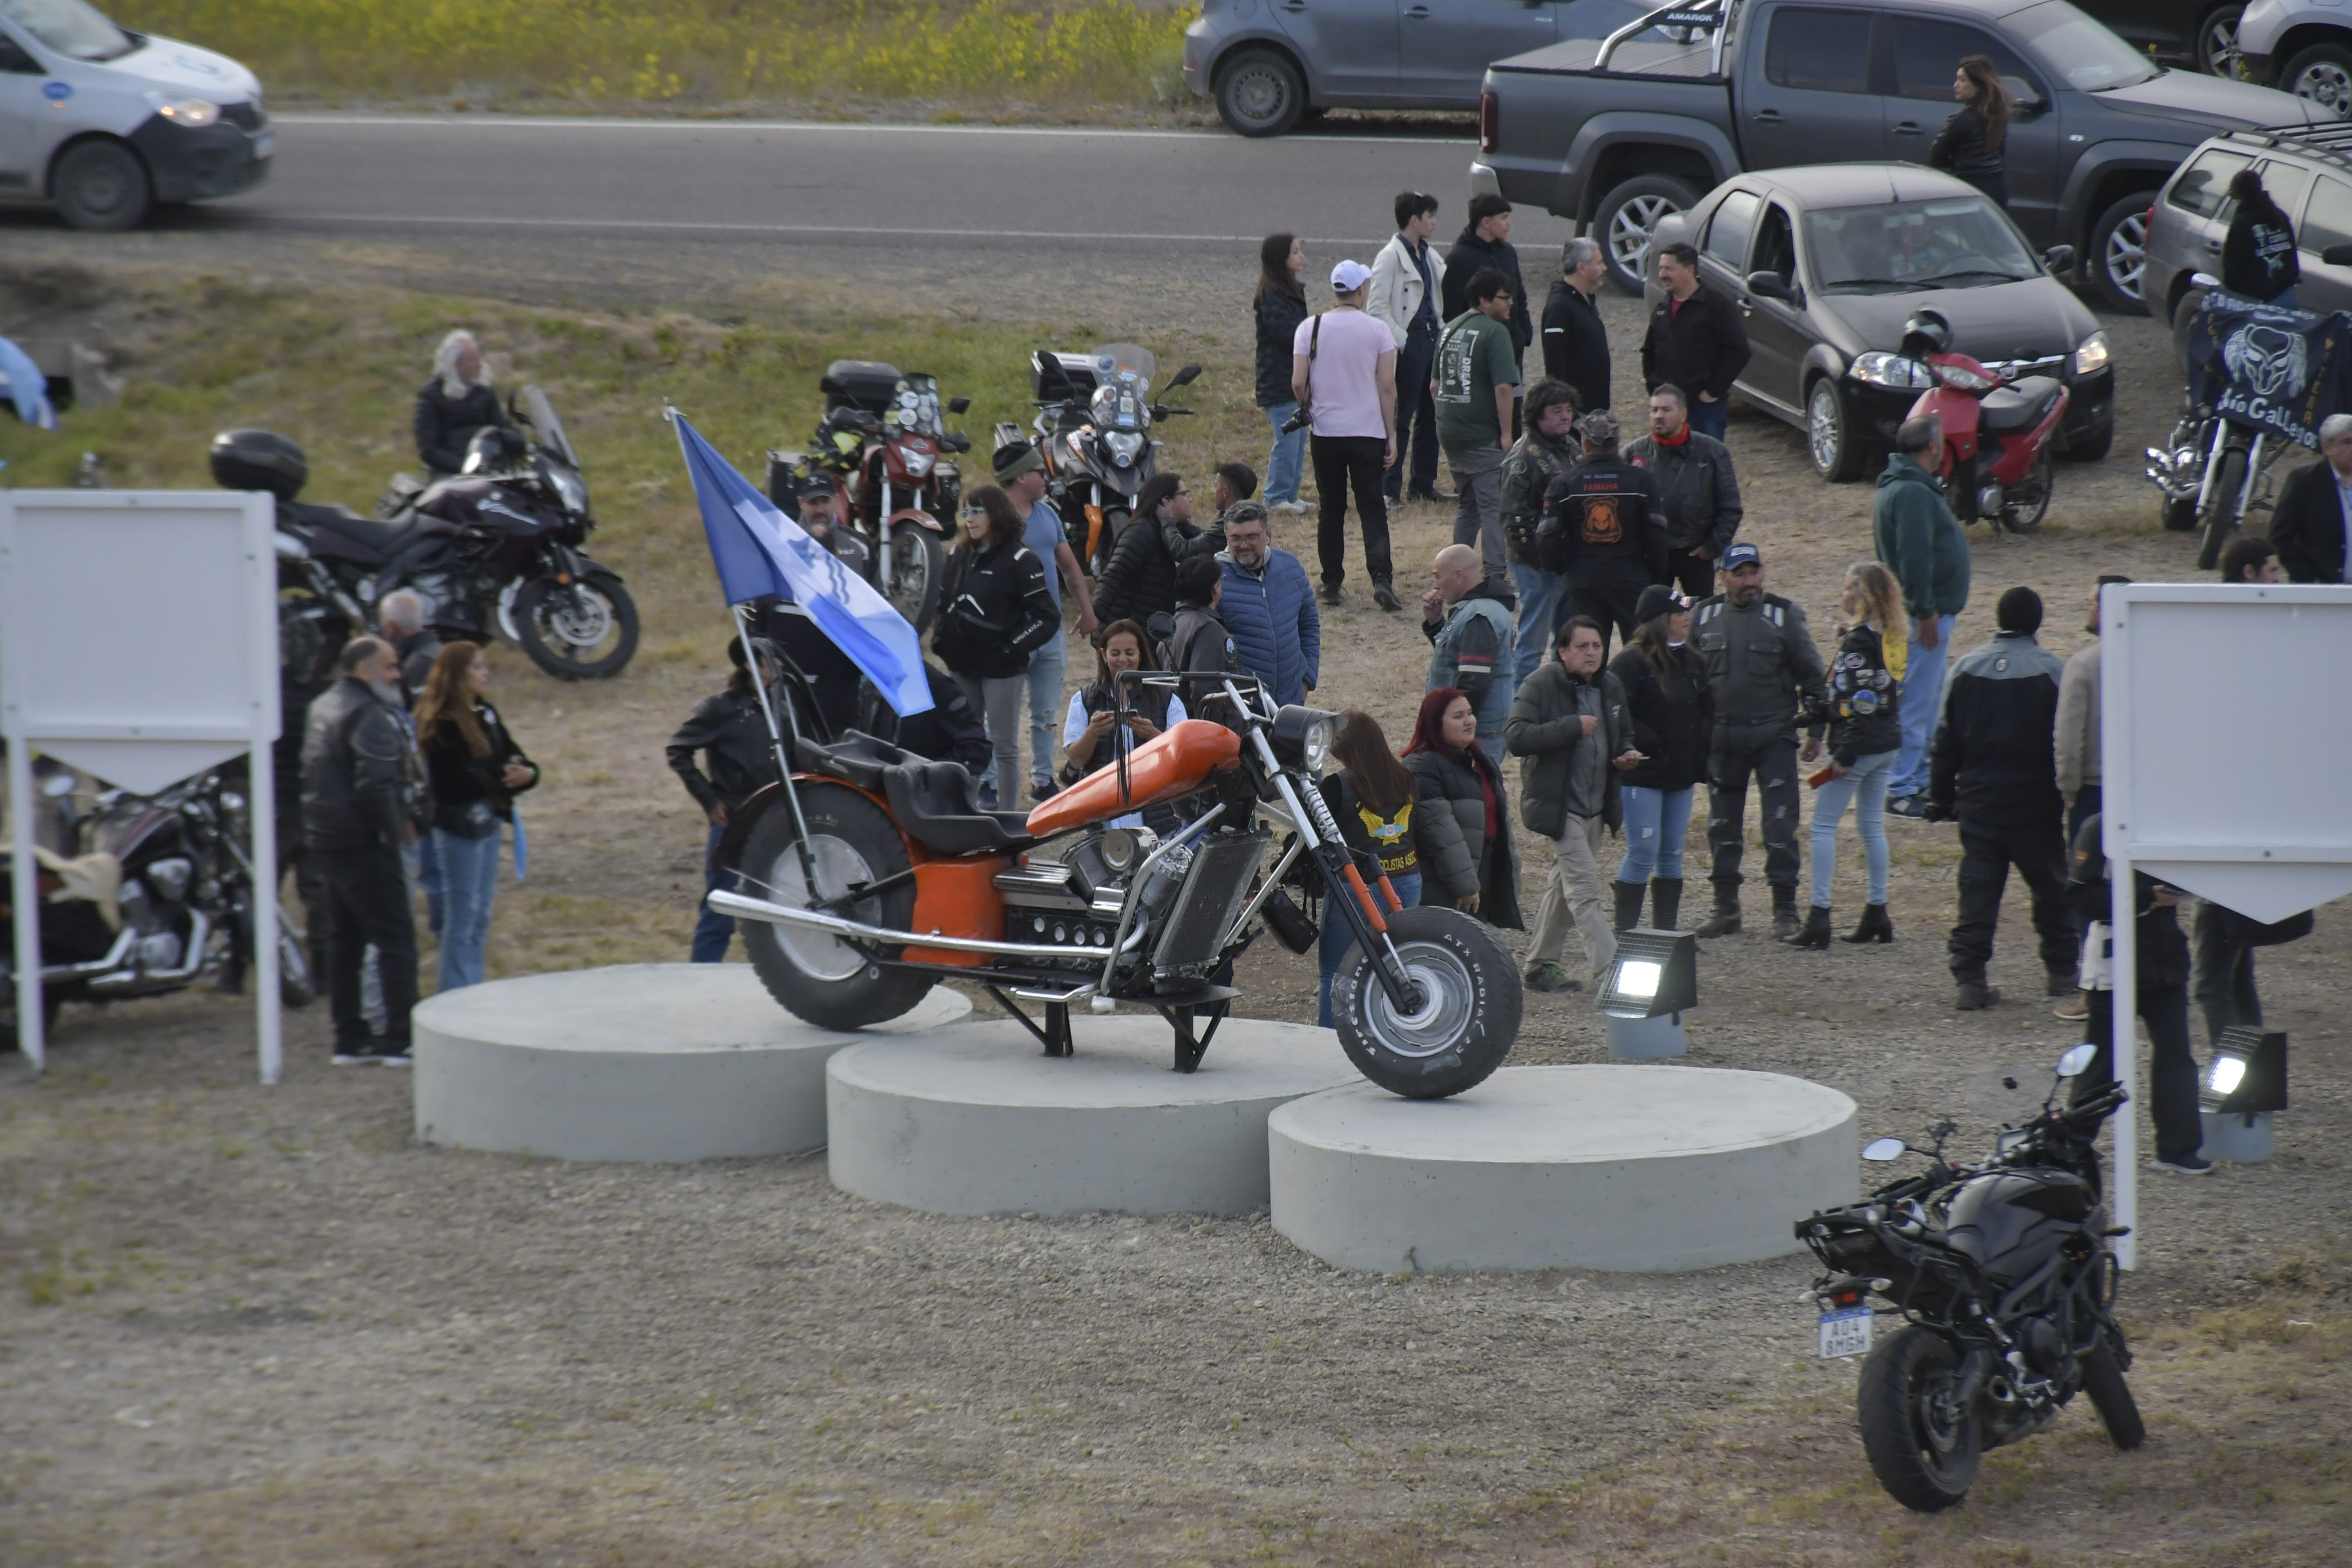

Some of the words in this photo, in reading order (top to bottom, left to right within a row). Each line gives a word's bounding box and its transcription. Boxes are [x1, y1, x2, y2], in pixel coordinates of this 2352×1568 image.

[1667, 12, 1714, 21] AMAROK
[1461, 357, 1472, 395] DREAM
[1027, 620, 1044, 634] AHEAD
[1444, 933, 1472, 957] ATX
